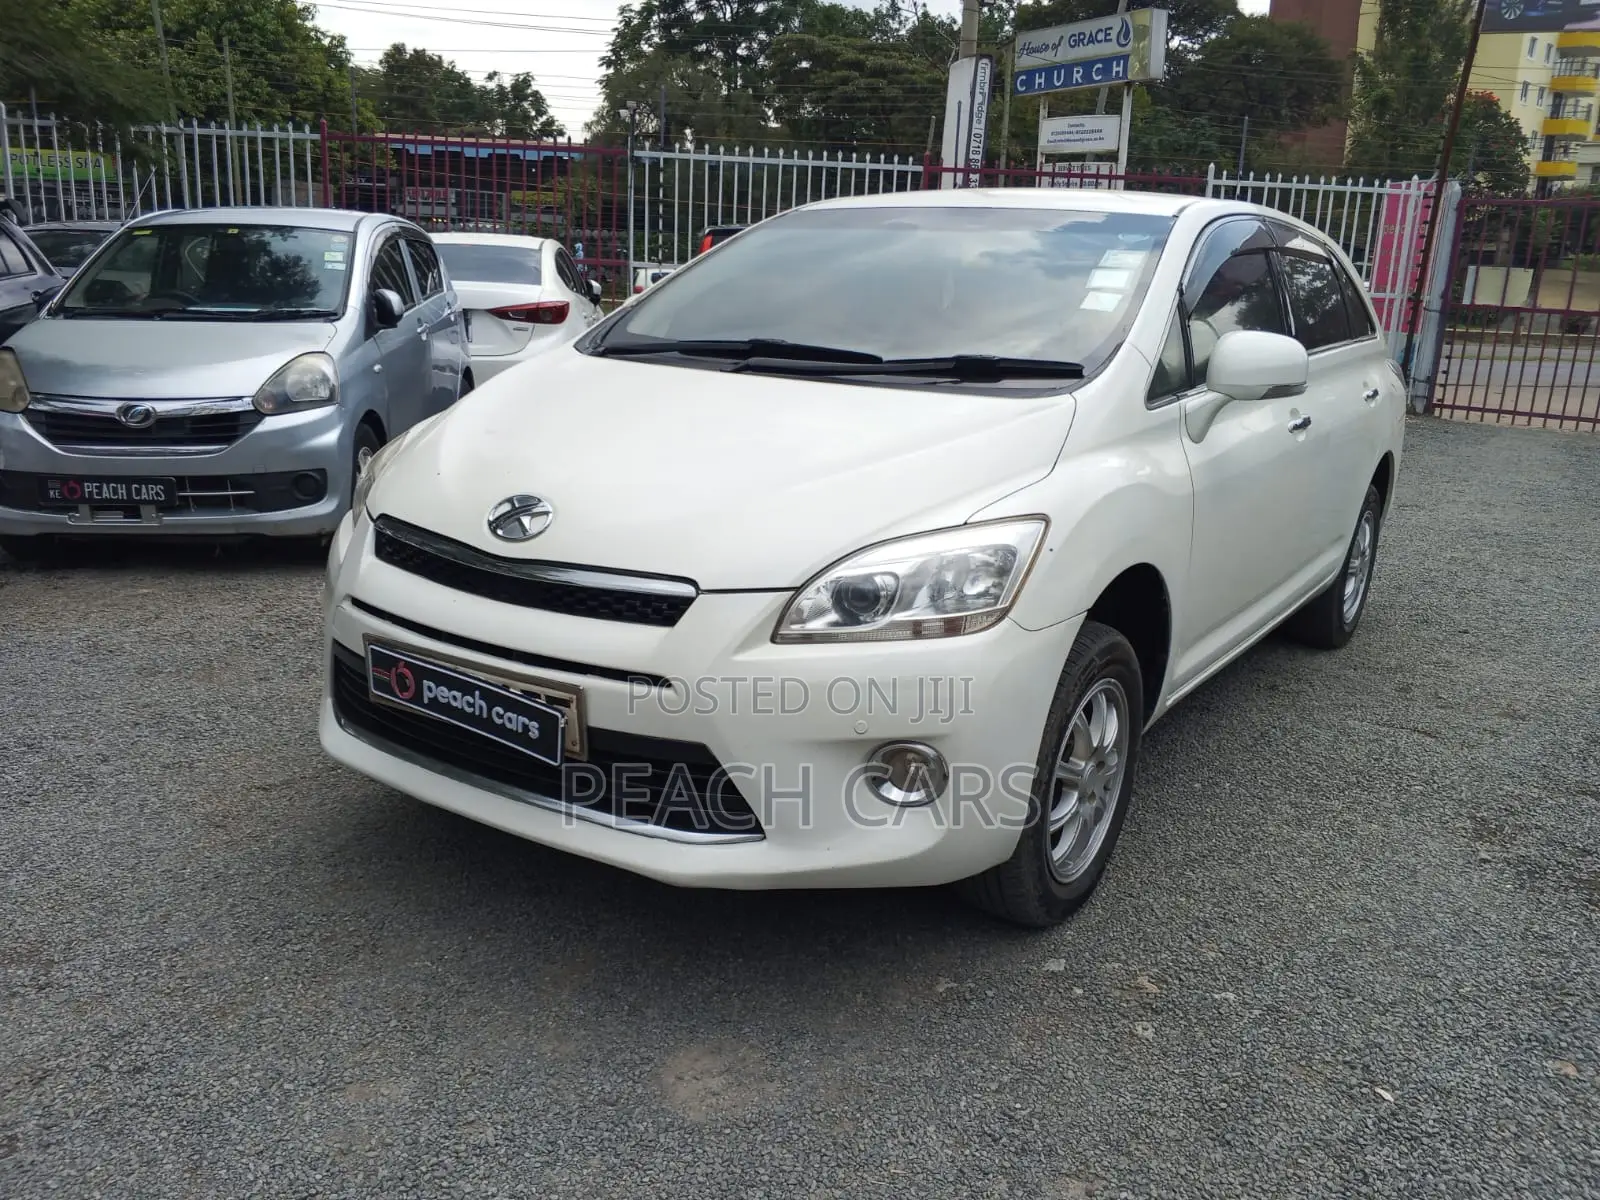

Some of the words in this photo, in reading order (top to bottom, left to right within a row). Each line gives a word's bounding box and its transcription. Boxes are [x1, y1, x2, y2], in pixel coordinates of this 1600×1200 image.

[1016, 40, 1049, 59] House
[1051, 35, 1064, 57] of
[1068, 27, 1113, 49] GRACE
[1016, 59, 1124, 92] CHURCH
[971, 132, 983, 156] 0718
[49, 489, 62, 499] KE
[84, 482, 128, 500] PEACH
[131, 484, 166, 501] CARS
[422, 679, 488, 719] peach
[491, 705, 540, 740] cars
